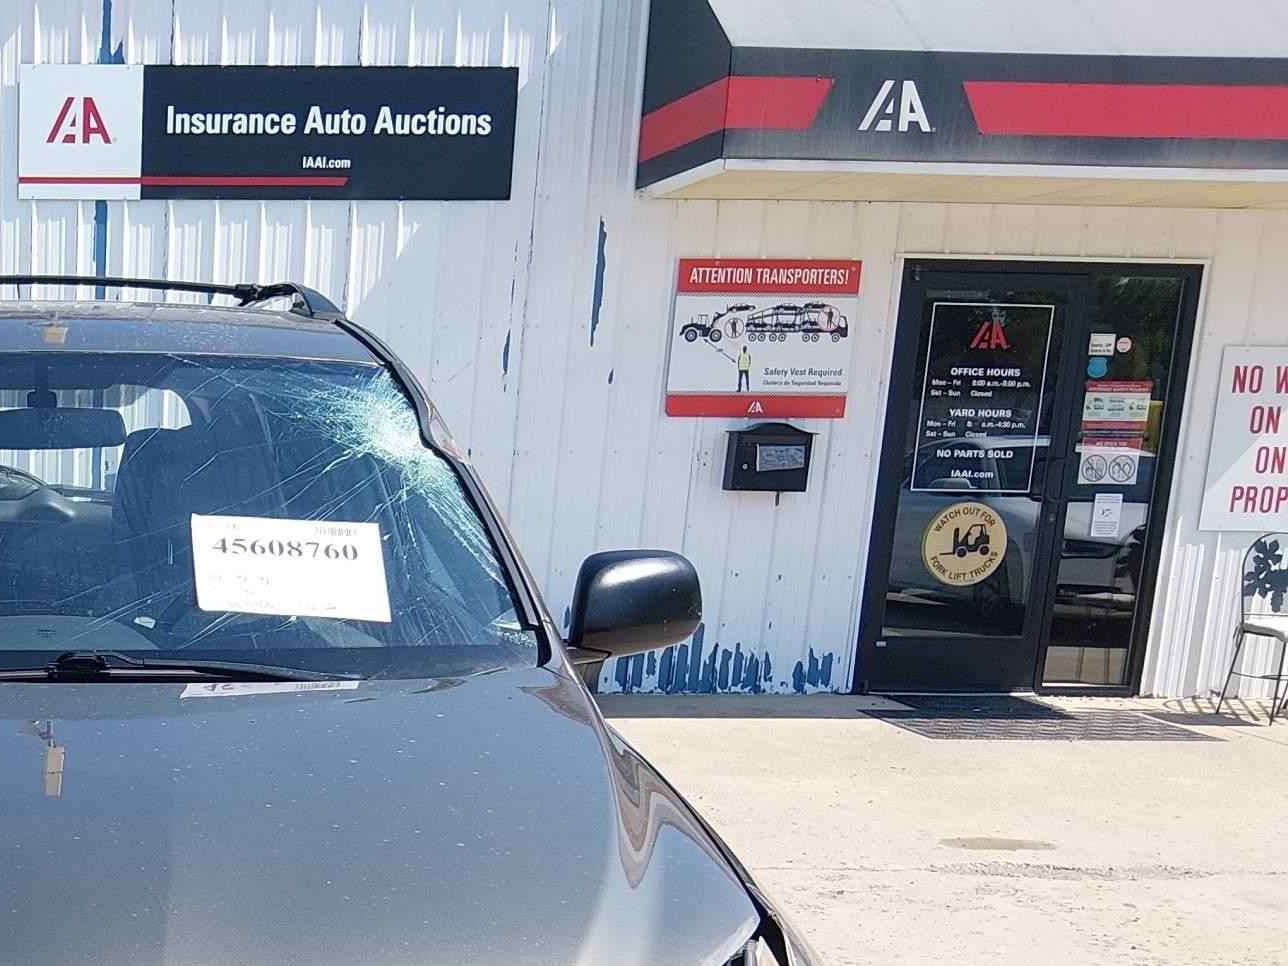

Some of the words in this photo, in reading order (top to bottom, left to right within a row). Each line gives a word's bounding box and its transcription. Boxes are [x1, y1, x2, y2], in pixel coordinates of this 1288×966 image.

[165, 105, 296, 136] Insurance
[304, 105, 367, 136] Auto
[373, 106, 492, 136] Auctions
[302, 156, 351, 169] IAAI.com
[689, 267, 753, 284] ATTENTION
[756, 268, 849, 285] TRANSPORTERS!
[763, 367, 788, 377] Safety
[790, 368, 807, 376] Vest
[808, 368, 843, 378] Required
[951, 367, 984, 376] OFFICE
[986, 368, 1021, 377] HOURS
[1231, 365, 1264, 394] NO
[949, 408, 975, 417] YARD
[977, 409, 1012, 418] HOURS
[1249, 405, 1281, 434] ON
[936, 449, 952, 458] NO
[954, 449, 985, 458] PARTS
[987, 450, 1013, 458] SOLD
[1255, 446, 1287, 474] ON
[951, 469, 994, 478] IAAI.com
[1229, 485, 1288, 513] PROP
[933, 507, 961, 533] WATCH
[962, 506, 979, 516] OUT
[979, 510, 996, 527] FOR
[211, 537, 359, 561] 45608760
[930, 555, 947, 577] FORK
[948, 571, 967, 581] LIFT
[968, 551, 999, 578] TRUCKS
